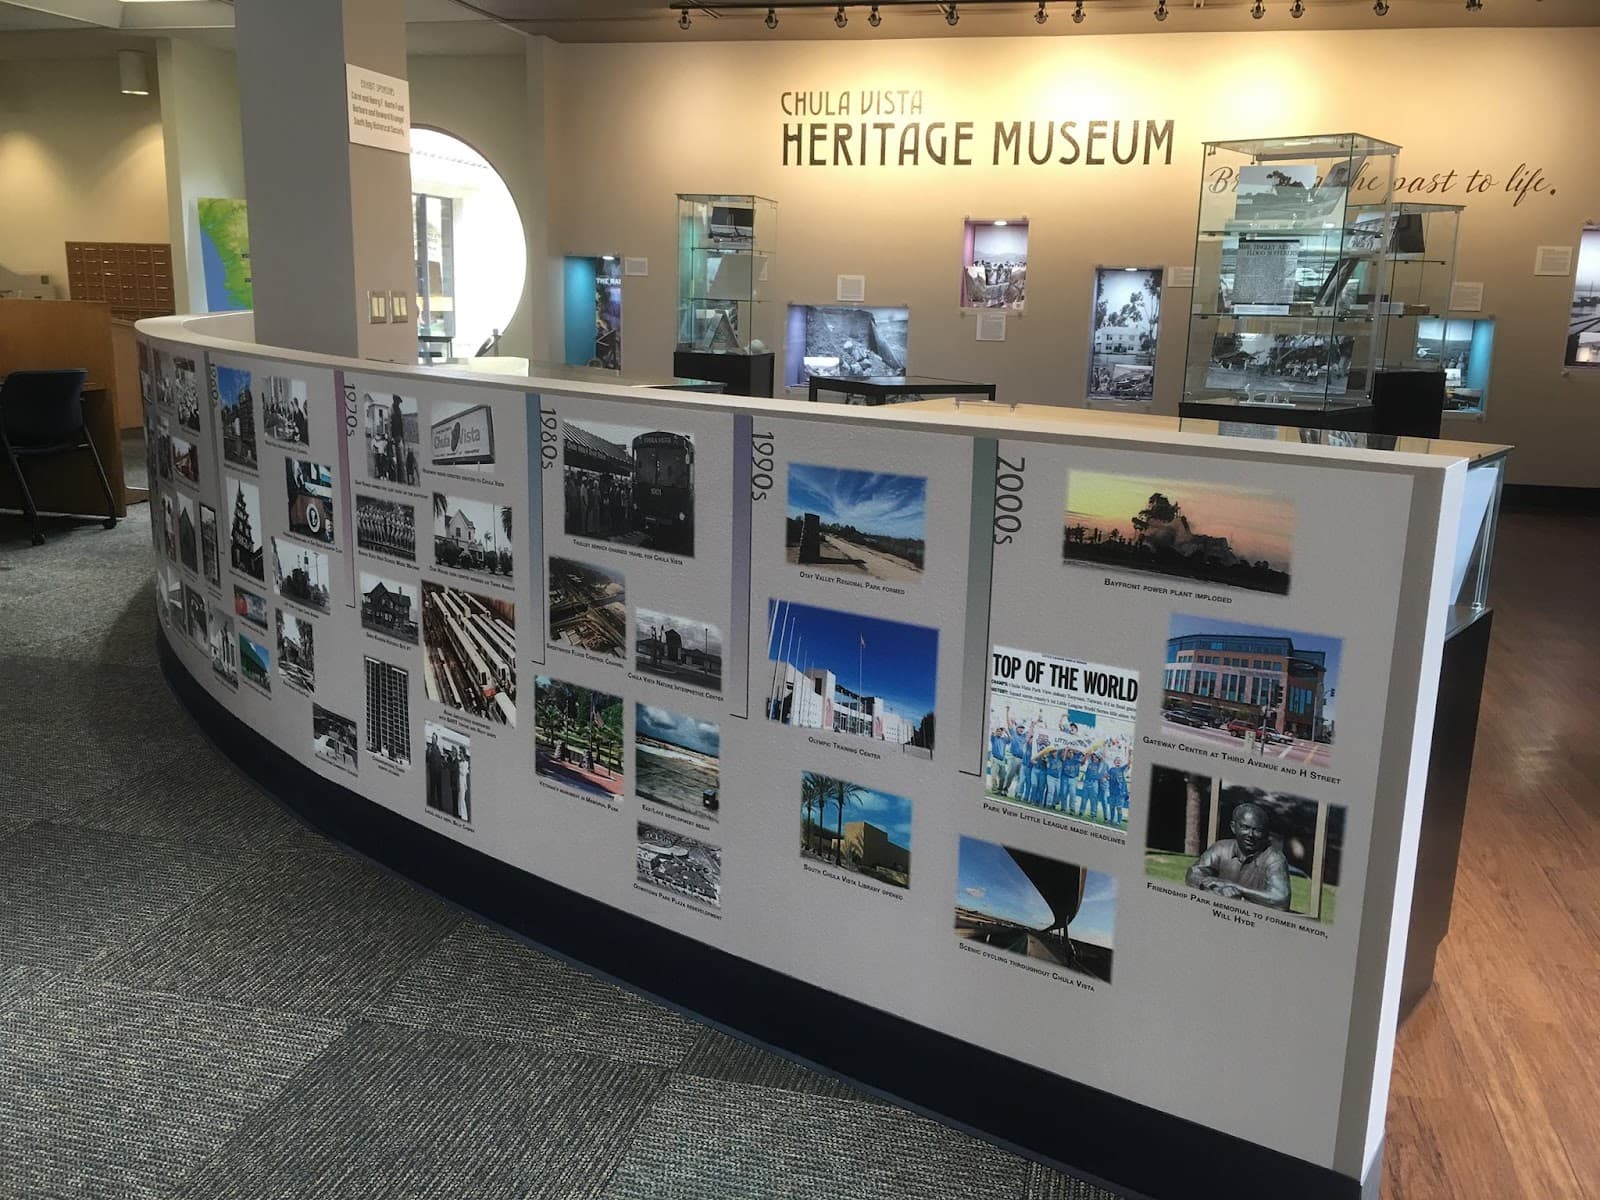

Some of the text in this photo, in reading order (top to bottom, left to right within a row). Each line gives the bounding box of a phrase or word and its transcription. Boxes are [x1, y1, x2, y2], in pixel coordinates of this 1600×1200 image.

[781, 90, 923, 116] CHULA VISTA
[782, 119, 1175, 166] HERITAGE MUSEUM
[1350, 162, 1385, 192] he
[1466, 168, 1497, 194] to
[1505, 162, 1557, 208] life.
[343, 383, 358, 437] 1970s
[540, 408, 557, 469] 1980s
[752, 431, 775, 501] 1990s
[994, 457, 1026, 544] 2000s
[653, 554, 668, 563] CHULA
[814, 572, 835, 583] VALLEY
[836, 576, 863, 588] REGIONAL
[865, 581, 880, 591] PARK
[1104, 577, 1232, 603] BAYFRONT POWER PLANT IMPLODED
[992, 653, 1138, 702] TOP OF THE WORLD
[808, 736, 880, 759] OLYMPIC TRAINING CENTER
[1142, 735, 1176, 749] GATEWAY
[1178, 743, 1208, 756] CENTER
[1221, 751, 1245, 763] THIRD
[1246, 757, 1278, 771] AVENUE
[1280, 767, 1296, 775] AND
[1299, 768, 1306, 777] H
[1309, 770, 1341, 784] STREET
[983, 802, 1125, 845] PARK VIEW LITTLE LEAGUE MADE HEADLINES
[822, 869, 840, 880] CHULA
[841, 875, 856, 886] VISTA
[857, 880, 880, 893] LIBRARY
[1146, 881, 1328, 939] FRIENDSHIP PARK MEMORIAL TO FORMER MAYOR,
[1212, 908, 1255, 927] WILL HYDE
[959, 941, 1095, 992] SCENIC CYCLING THROUGHOUT CHULA VISTA
